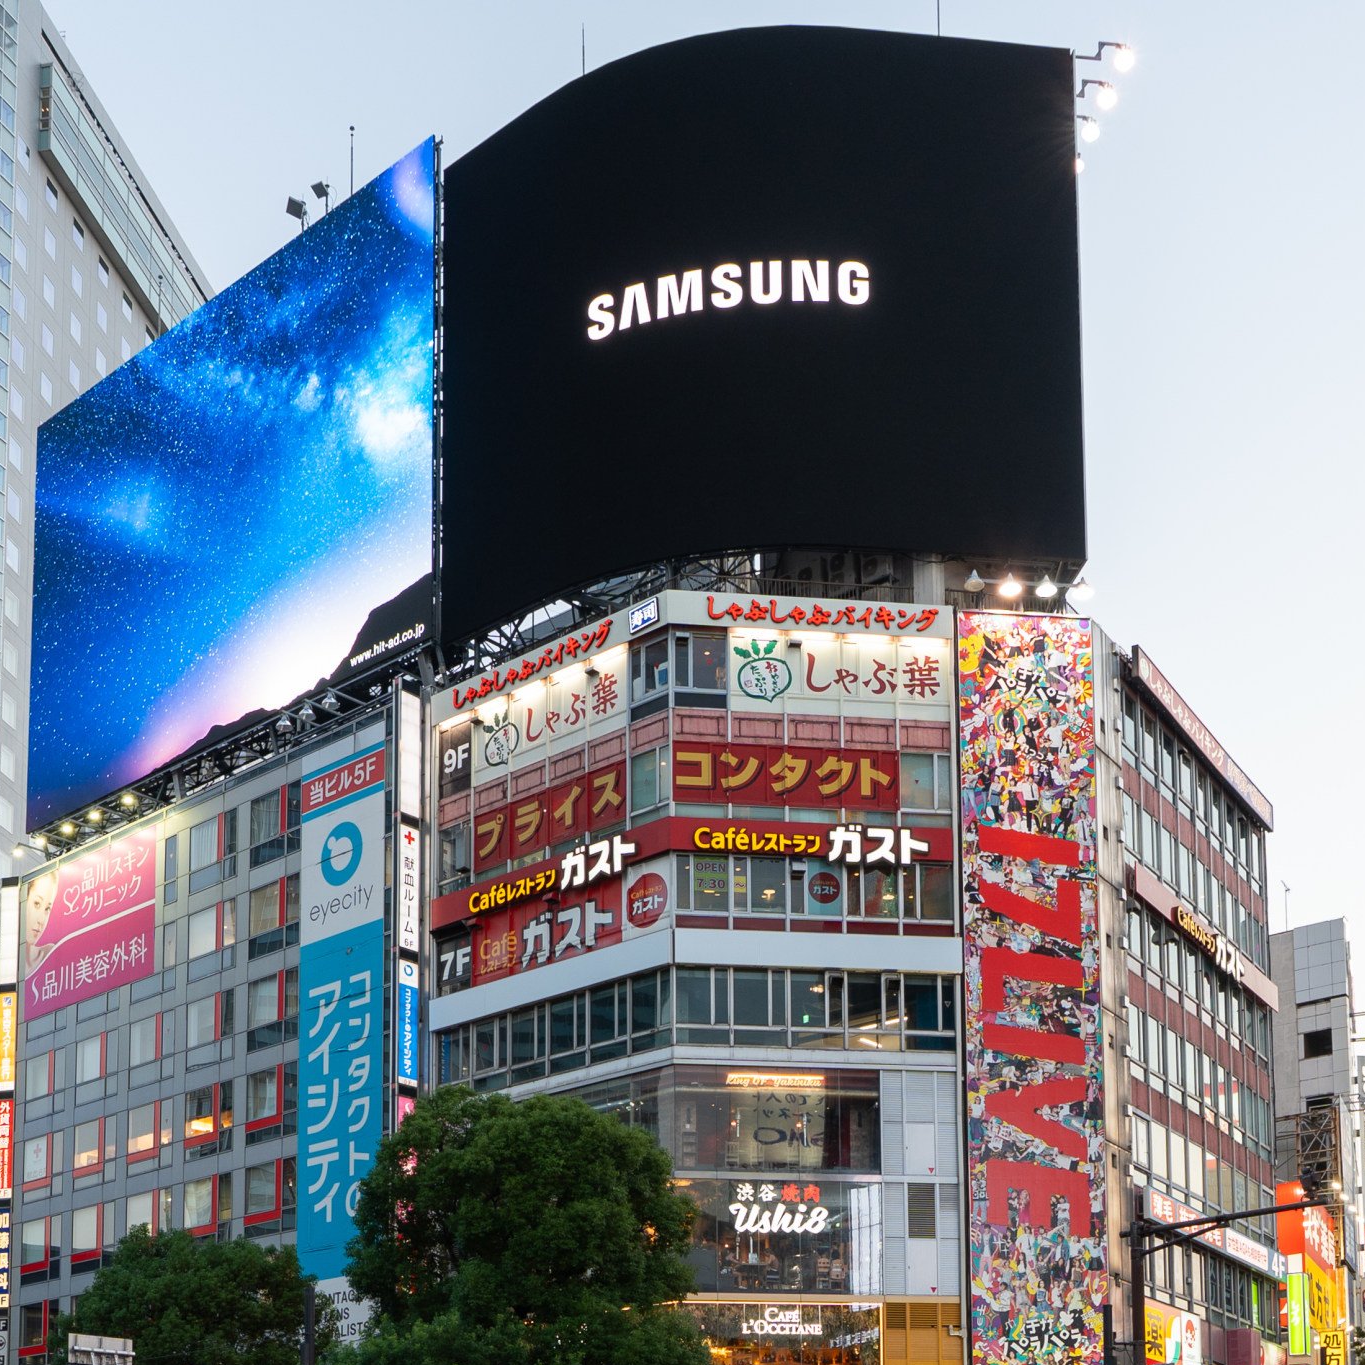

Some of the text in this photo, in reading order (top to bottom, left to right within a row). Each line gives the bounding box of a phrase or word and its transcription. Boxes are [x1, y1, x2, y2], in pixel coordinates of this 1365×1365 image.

[587, 259, 871, 341] SAMSUNG
[632, 602, 656, 629] 寿司
[706, 595, 939, 632] しゃぶしゃぶバイキング
[349, 623, 425, 667] www.hit-ad.co.jp
[451, 619, 614, 709] しゃぶしゃぶバイキング
[805, 652, 941, 699] しゃぶ葉
[526, 673, 619, 742] しゃぶ葉
[309, 756, 377, 806] 当ビル5F
[443, 743, 470, 774] 9F
[675, 751, 891, 797] コンタクト
[476, 769, 623, 858] プライス
[560, 835, 636, 890] ガスト
[827, 823, 930, 865] ガスト
[81, 845, 150, 894] 品川スキン
[695, 861, 726, 873] OPEN
[696, 878, 726, 889] 7:30
[81, 873, 142, 919] クリニック
[309, 884, 374, 926] eyecity
[403, 855, 415, 935] 献血ルーム
[631, 894, 664, 917] ガスト
[812, 885, 838, 895] ガスト
[404, 938, 414, 948] 6F
[521, 901, 613, 970] ガスト
[41, 932, 148, 1002] 品川美容外科
[440, 946, 471, 980] 7F
[306, 979, 342, 1223] アイシティ
[344, 969, 371, 1218] コンタクトの
[729, 1202, 829, 1234] Ushi8
[1271, 1251, 1285, 1278] 4F
[1146, 1312, 1164, 1357] 薬
